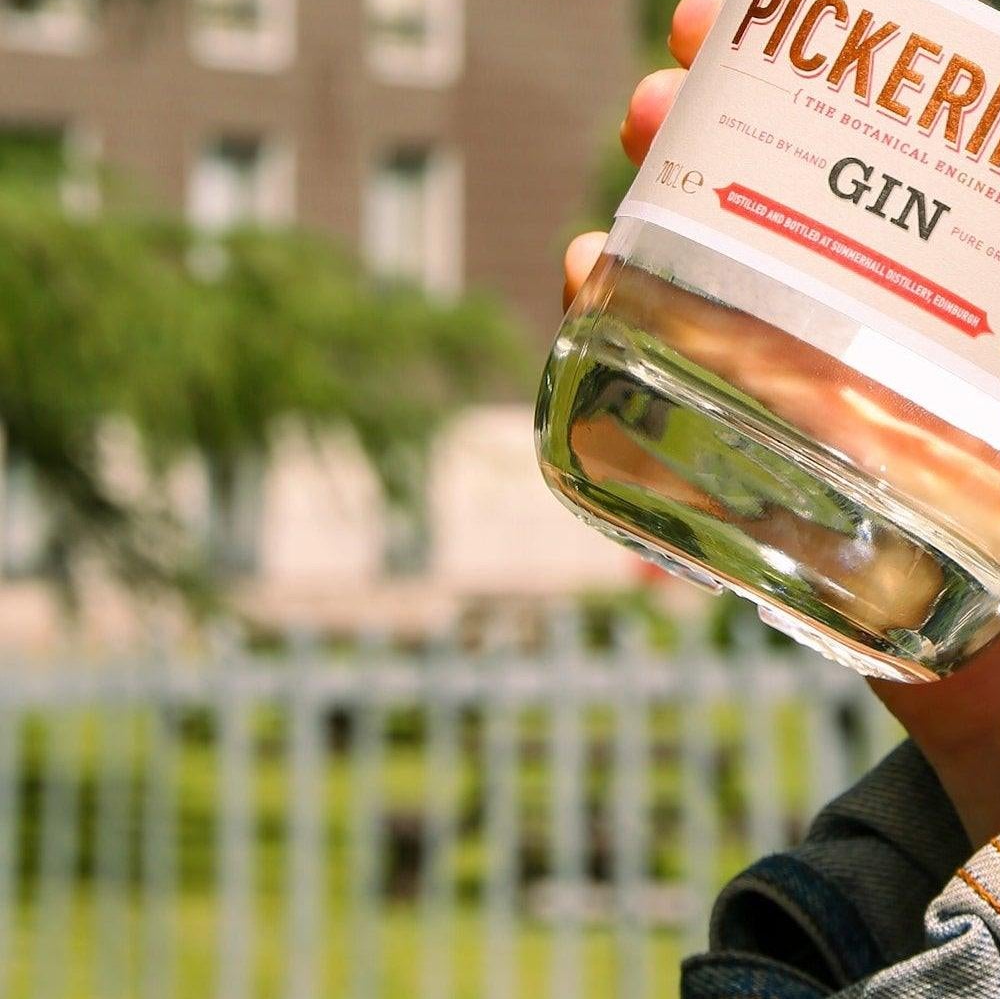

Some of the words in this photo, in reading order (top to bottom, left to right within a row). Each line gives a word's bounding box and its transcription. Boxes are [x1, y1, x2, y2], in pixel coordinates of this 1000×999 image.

[718, 113, 775, 145] DISTILLED
[776, 139, 794, 153] BY
[793, 146, 827, 170] HAND
[805, 95, 834, 118] THE
[839, 113, 930, 164] BOTANICAL
[828, 157, 951, 241] GIN
[726, 191, 767, 217] DISTILLED
[765, 210, 785, 224] AND
[783, 218, 821, 242] BOTTLED
[818, 234, 834, 247] AT
[831, 240, 886, 276] SUMMERHALL
[933, 295, 981, 327] EDINBURGH
[950, 226, 984, 251] PURE
